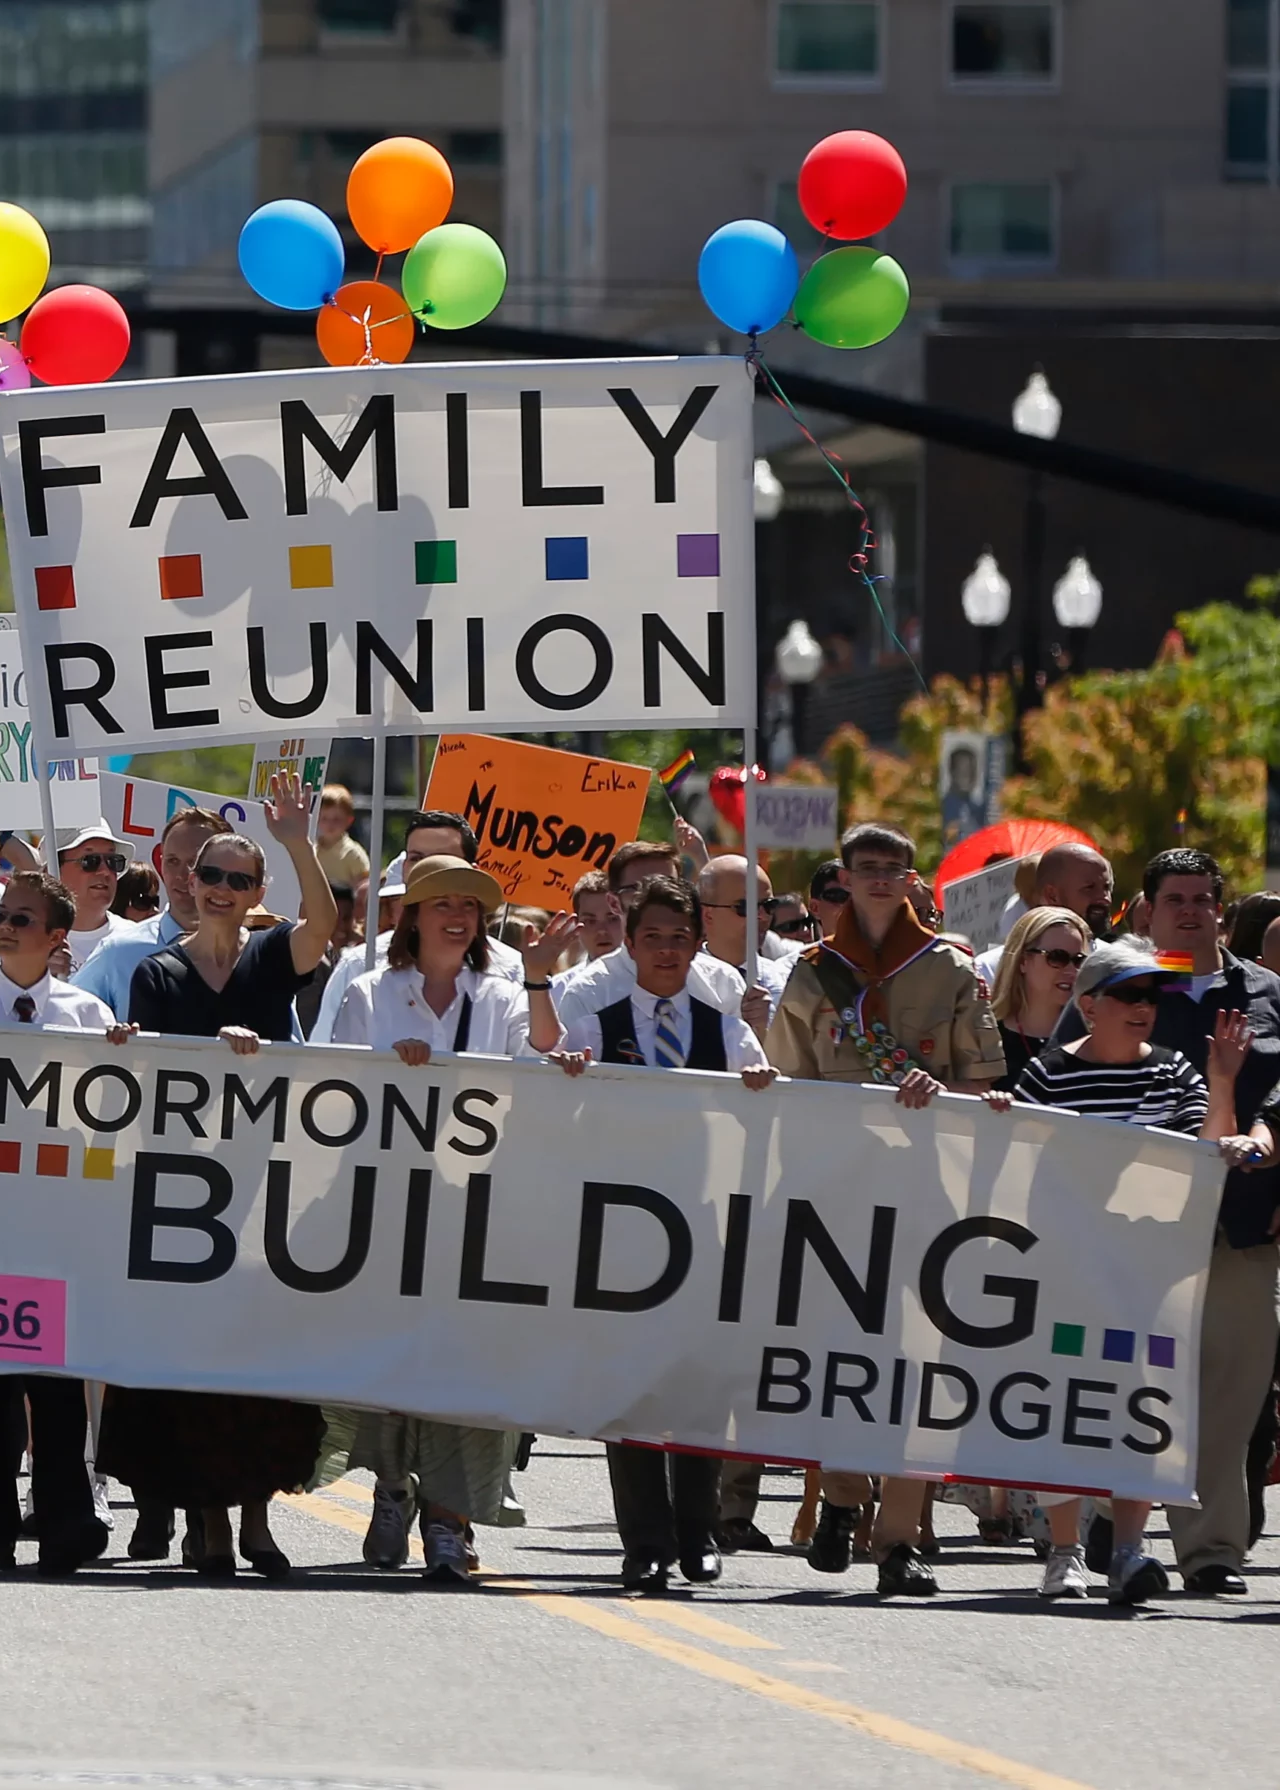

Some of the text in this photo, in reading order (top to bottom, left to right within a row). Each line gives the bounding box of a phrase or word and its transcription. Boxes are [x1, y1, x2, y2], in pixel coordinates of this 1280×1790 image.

[18, 385, 720, 537] FAMILY
[43, 610, 726, 738] REUNION
[463, 779, 616, 870] Munson
[581, 762, 637, 793] Erika
[127, 1151, 1041, 1349] BUILDING
[756, 1346, 1175, 1455] BRIDGES
